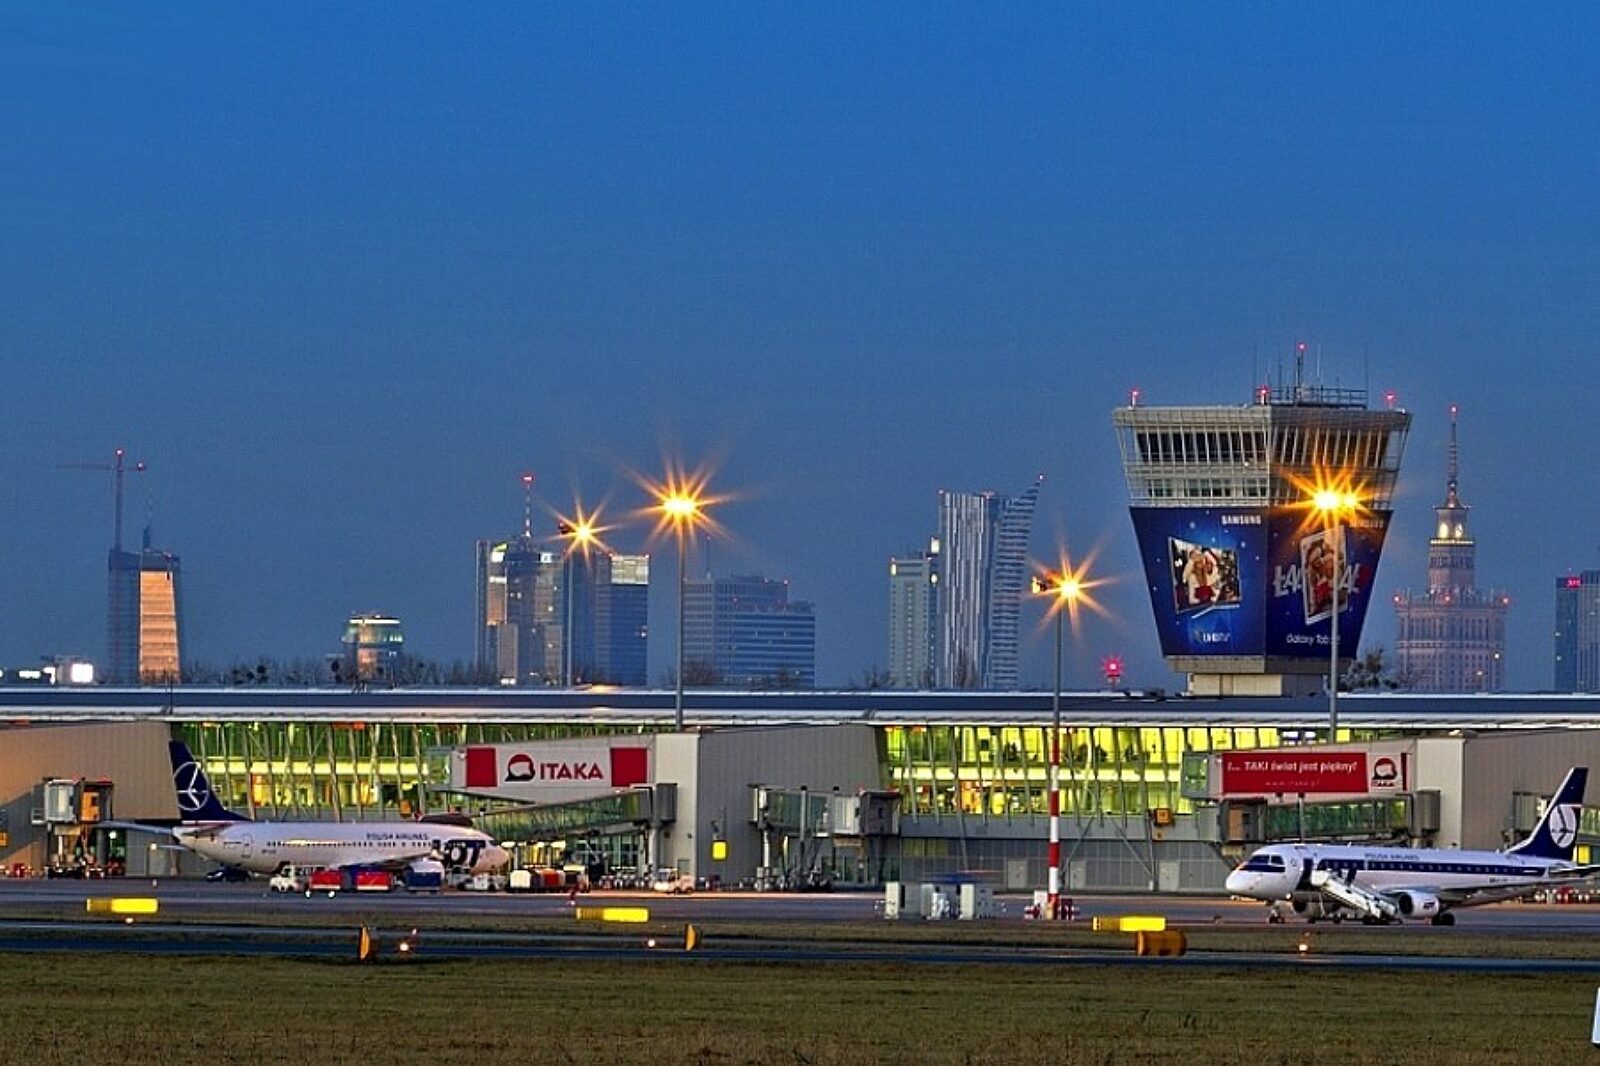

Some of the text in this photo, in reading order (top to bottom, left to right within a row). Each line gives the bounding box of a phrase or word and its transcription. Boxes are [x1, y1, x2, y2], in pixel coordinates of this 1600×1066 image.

[1221, 514, 1261, 525] SAMSUNG
[1286, 632, 1315, 647] Galaxy
[540, 762, 604, 780] ITAKA
[1244, 761, 1269, 771] TAKI
[1299, 761, 1318, 774] jest
